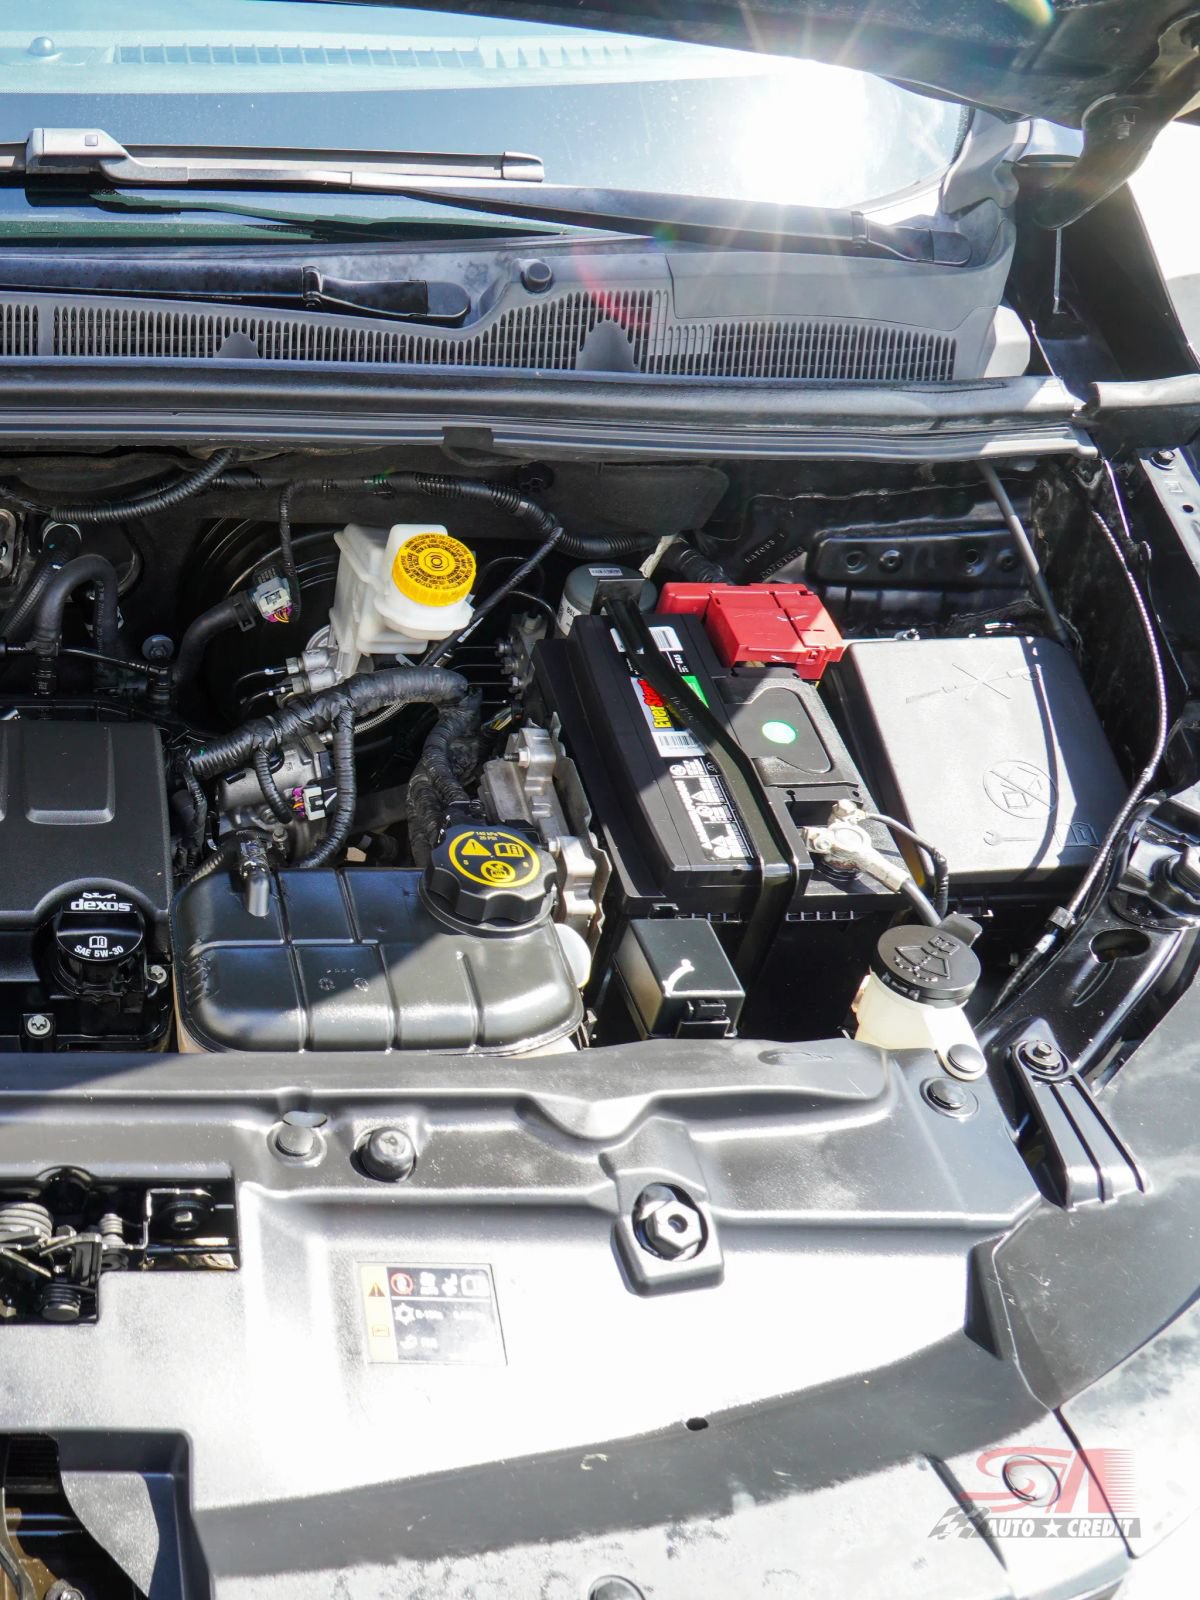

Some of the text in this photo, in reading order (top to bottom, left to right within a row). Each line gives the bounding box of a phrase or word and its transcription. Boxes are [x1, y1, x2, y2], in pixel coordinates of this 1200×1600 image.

[71, 899, 132, 911] dexos
[74, 945, 124, 957] SAE 5W-30
